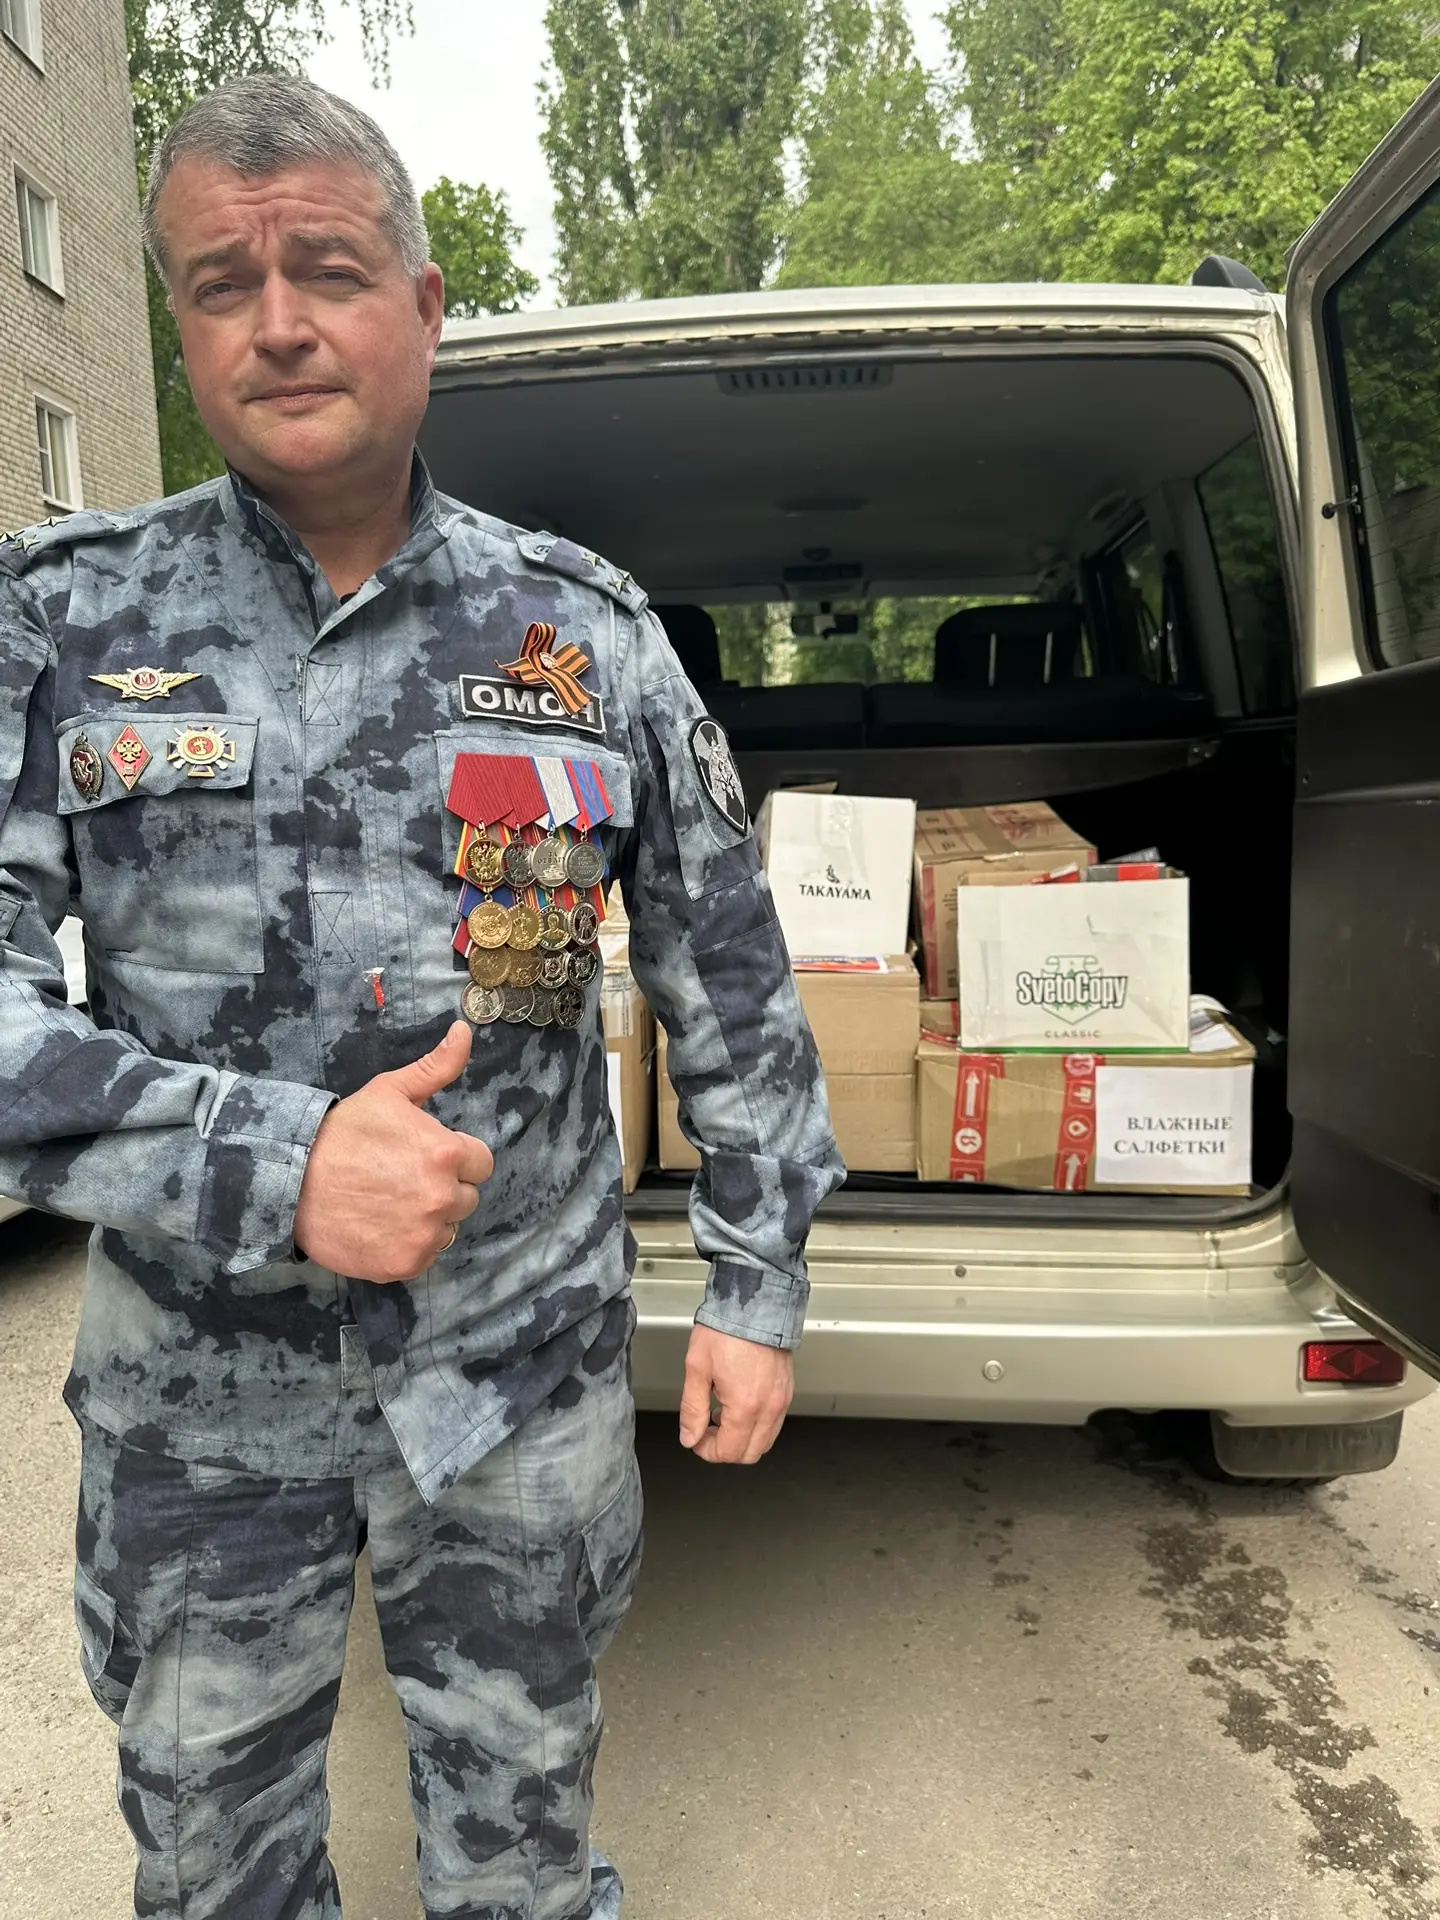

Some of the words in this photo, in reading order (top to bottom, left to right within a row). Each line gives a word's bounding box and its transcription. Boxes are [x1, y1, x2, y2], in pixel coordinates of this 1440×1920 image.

[799, 884, 872, 900] TAKAYAMA
[1016, 971, 1128, 1009] SvetoCopy
[1044, 1030, 1101, 1038] CLASSIC
[1127, 1117, 1233, 1131] ВЛАЖНЫЕ
[1114, 1139, 1226, 1154] САЛФЕТКИ
